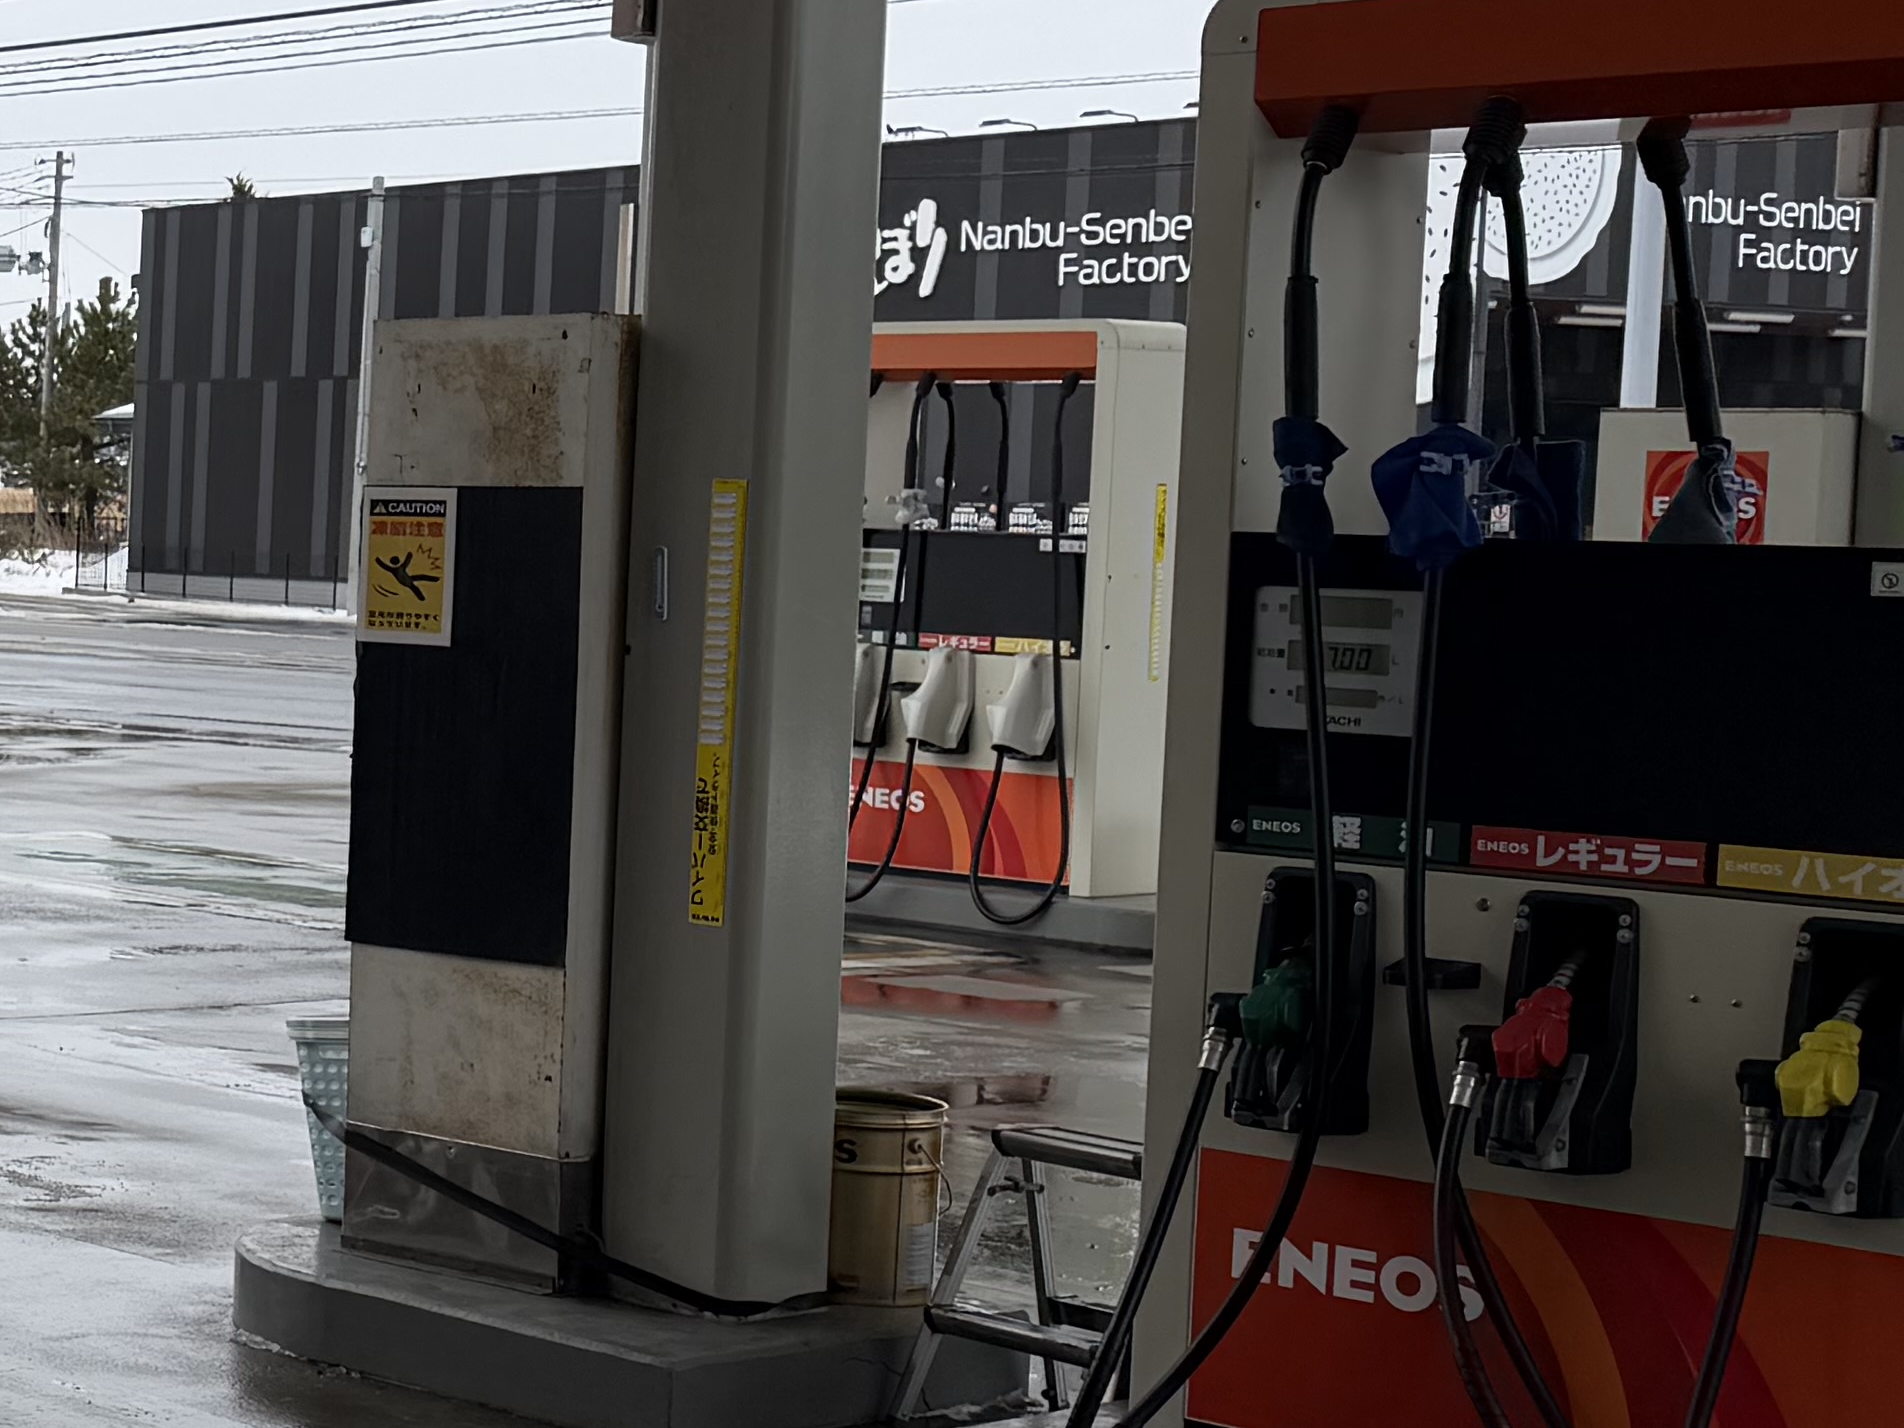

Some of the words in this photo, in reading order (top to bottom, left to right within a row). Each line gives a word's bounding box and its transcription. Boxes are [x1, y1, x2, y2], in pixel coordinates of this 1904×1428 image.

[959, 208, 1192, 254] Nanbu-Senbe
[1683, 188, 1861, 233] nbu-Senbei
[873, 197, 948, 299] ぼり
[1058, 251, 1191, 287] Factory
[1737, 232, 1859, 275] Factory
[387, 501, 446, 516] CAUTION
[1251, 819, 1302, 836] ENEOS
[1476, 839, 1530, 858] ENEOS
[1533, 834, 1699, 878] レギュラー
[1724, 858, 1784, 877] ENEOS
